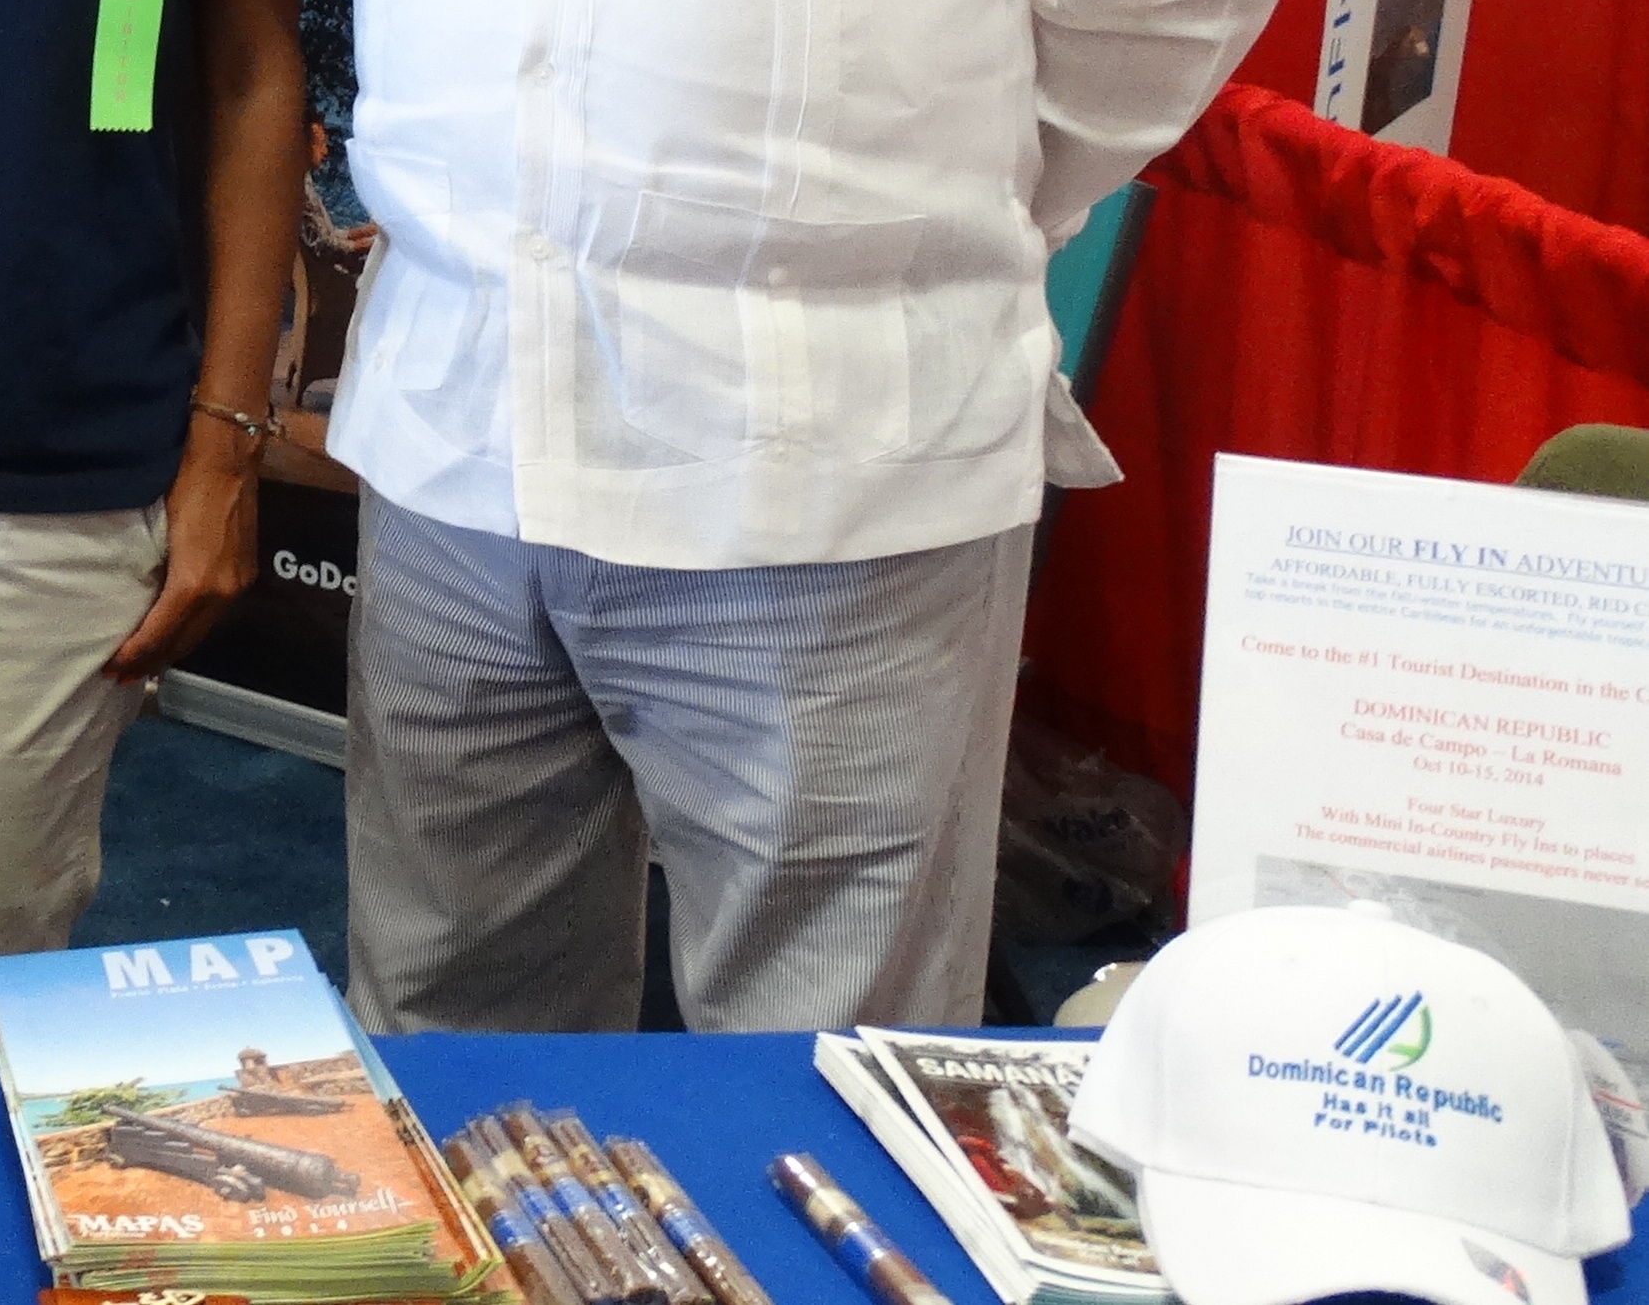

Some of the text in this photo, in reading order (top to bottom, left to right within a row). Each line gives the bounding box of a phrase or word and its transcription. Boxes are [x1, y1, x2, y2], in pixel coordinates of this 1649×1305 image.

[1286, 524, 1342, 550] JOIN
[1350, 532, 1403, 557] OUR
[1413, 539, 1469, 564] FLY
[1478, 546, 1509, 567] IN
[1271, 557, 1401, 588] AFFORDABLE,
[1406, 572, 1470, 595] FULLY
[1476, 582, 1582, 611] ESCORTED,
[1588, 595, 1629, 614] RED
[1241, 634, 1630, 702] Come to the #1 Tourist Destination in the
[1340, 721, 1624, 777] Casa de Campo La Romana
[1354, 698, 1612, 749] DOMINICAN REPUBLIC
[1413, 755, 1442, 774] Oct
[1504, 767, 1545, 787] 2014
[1408, 797, 1445, 816] Four
[1450, 803, 1482, 822] Star
[1295, 822, 1630, 886] The commercial airlines passengers never
[1321, 805, 1360, 825] With
[1501, 832, 1528, 852] Fly
[1563, 843, 1579, 857] to
[1583, 846, 1636, 866] places
[102, 937, 295, 991] MAP
[1248, 1053, 1503, 1124] Dominican Republic
[1323, 1091, 1431, 1129] Has it all
[1314, 1112, 1438, 1148] For Pilots
[69, 1213, 206, 1239] MAPAS
[248, 1203, 298, 1226] Find
